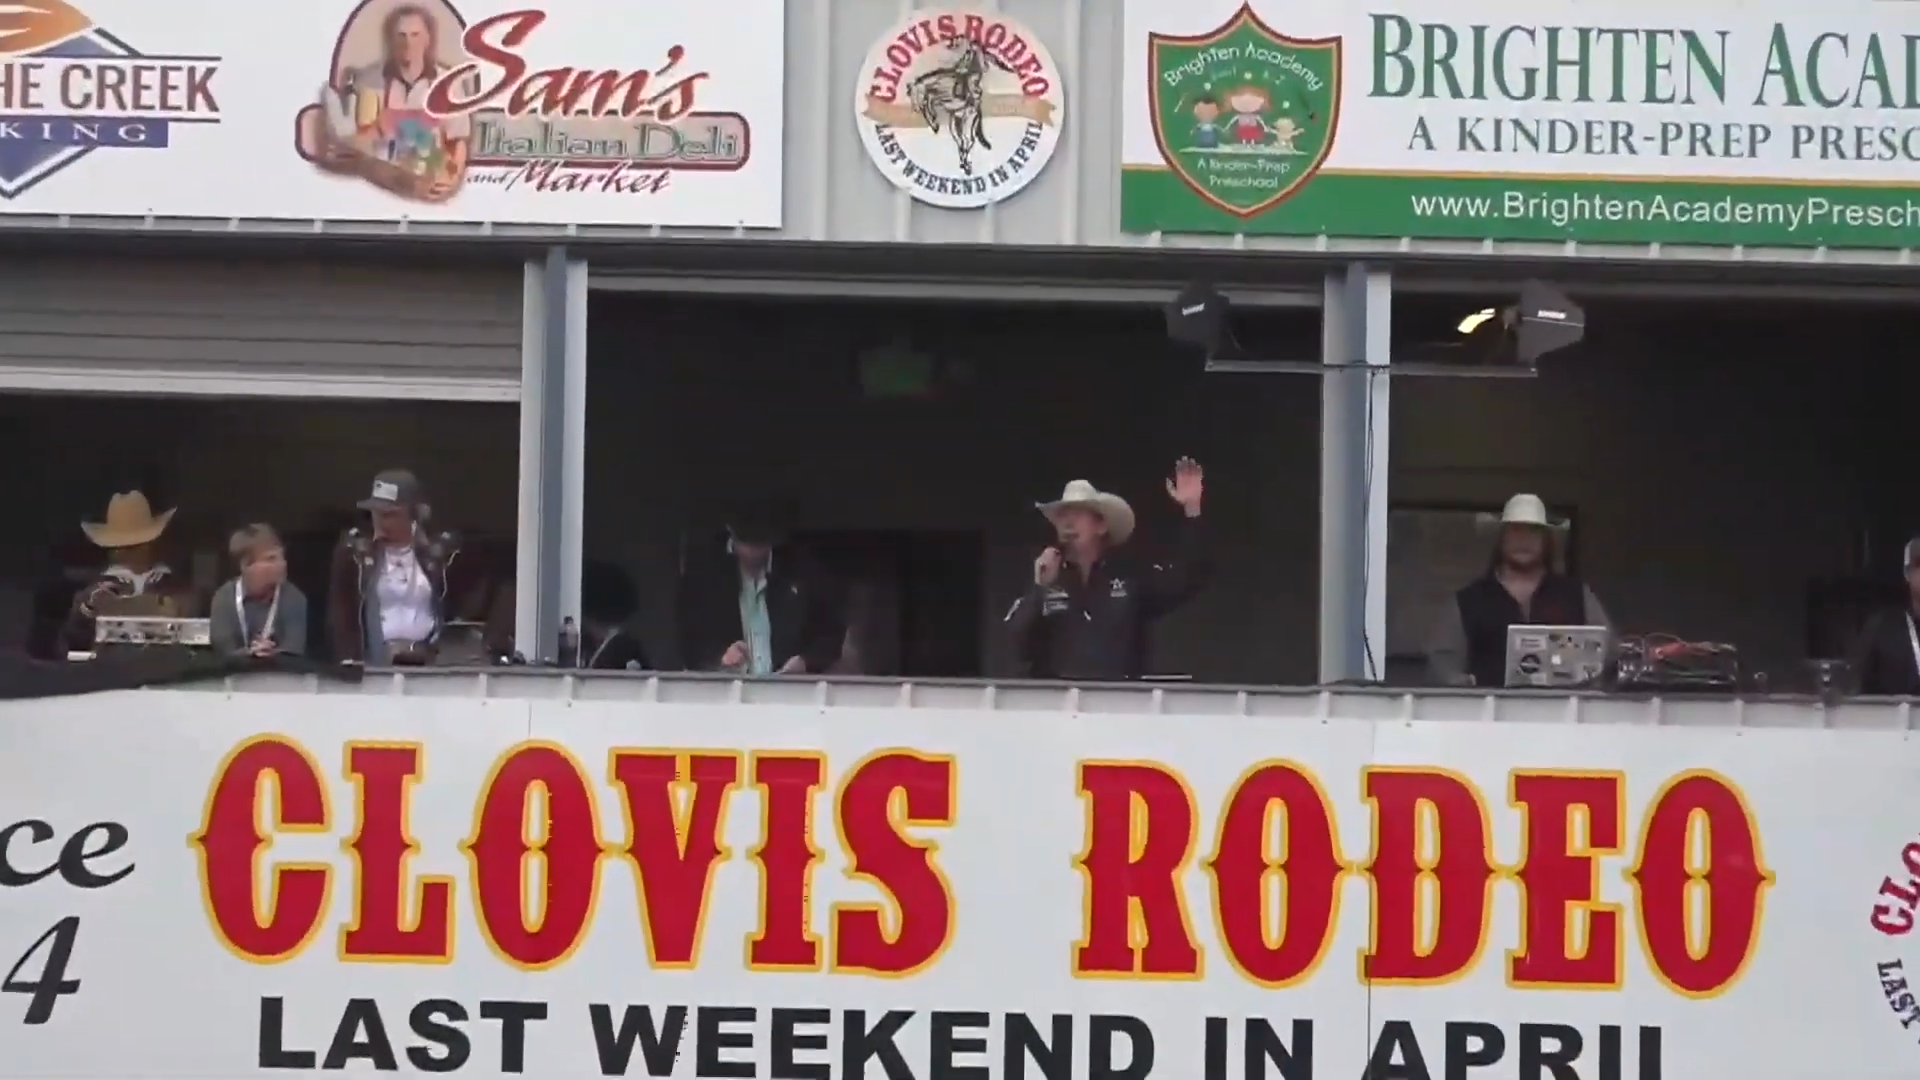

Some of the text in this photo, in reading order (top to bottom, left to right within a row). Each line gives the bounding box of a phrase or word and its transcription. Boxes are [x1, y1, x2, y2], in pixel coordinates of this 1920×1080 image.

[60, 64, 220, 112] CREEK
[426, 10, 709, 121] Sam's
[870, 14, 1049, 103] CLOVIS RODEO
[1164, 42, 1323, 91] Brighten Academy
[1368, 13, 1732, 106] BRIGHTEN
[477, 119, 738, 160] Italian Deli
[504, 158, 670, 193] Market
[875, 121, 1043, 194] LAST WEEKEND IN APRIL
[1408, 116, 1435, 150] A
[1458, 117, 1771, 158] KINDER-PREP
[187, 733, 1776, 999] CLOVIS RODEO
[1, 917, 81, 1025] 4
[259, 996, 547, 1074] LAST
[588, 1003, 1155, 1080] WEEKEND
[1204, 1017, 1314, 1080] IN
